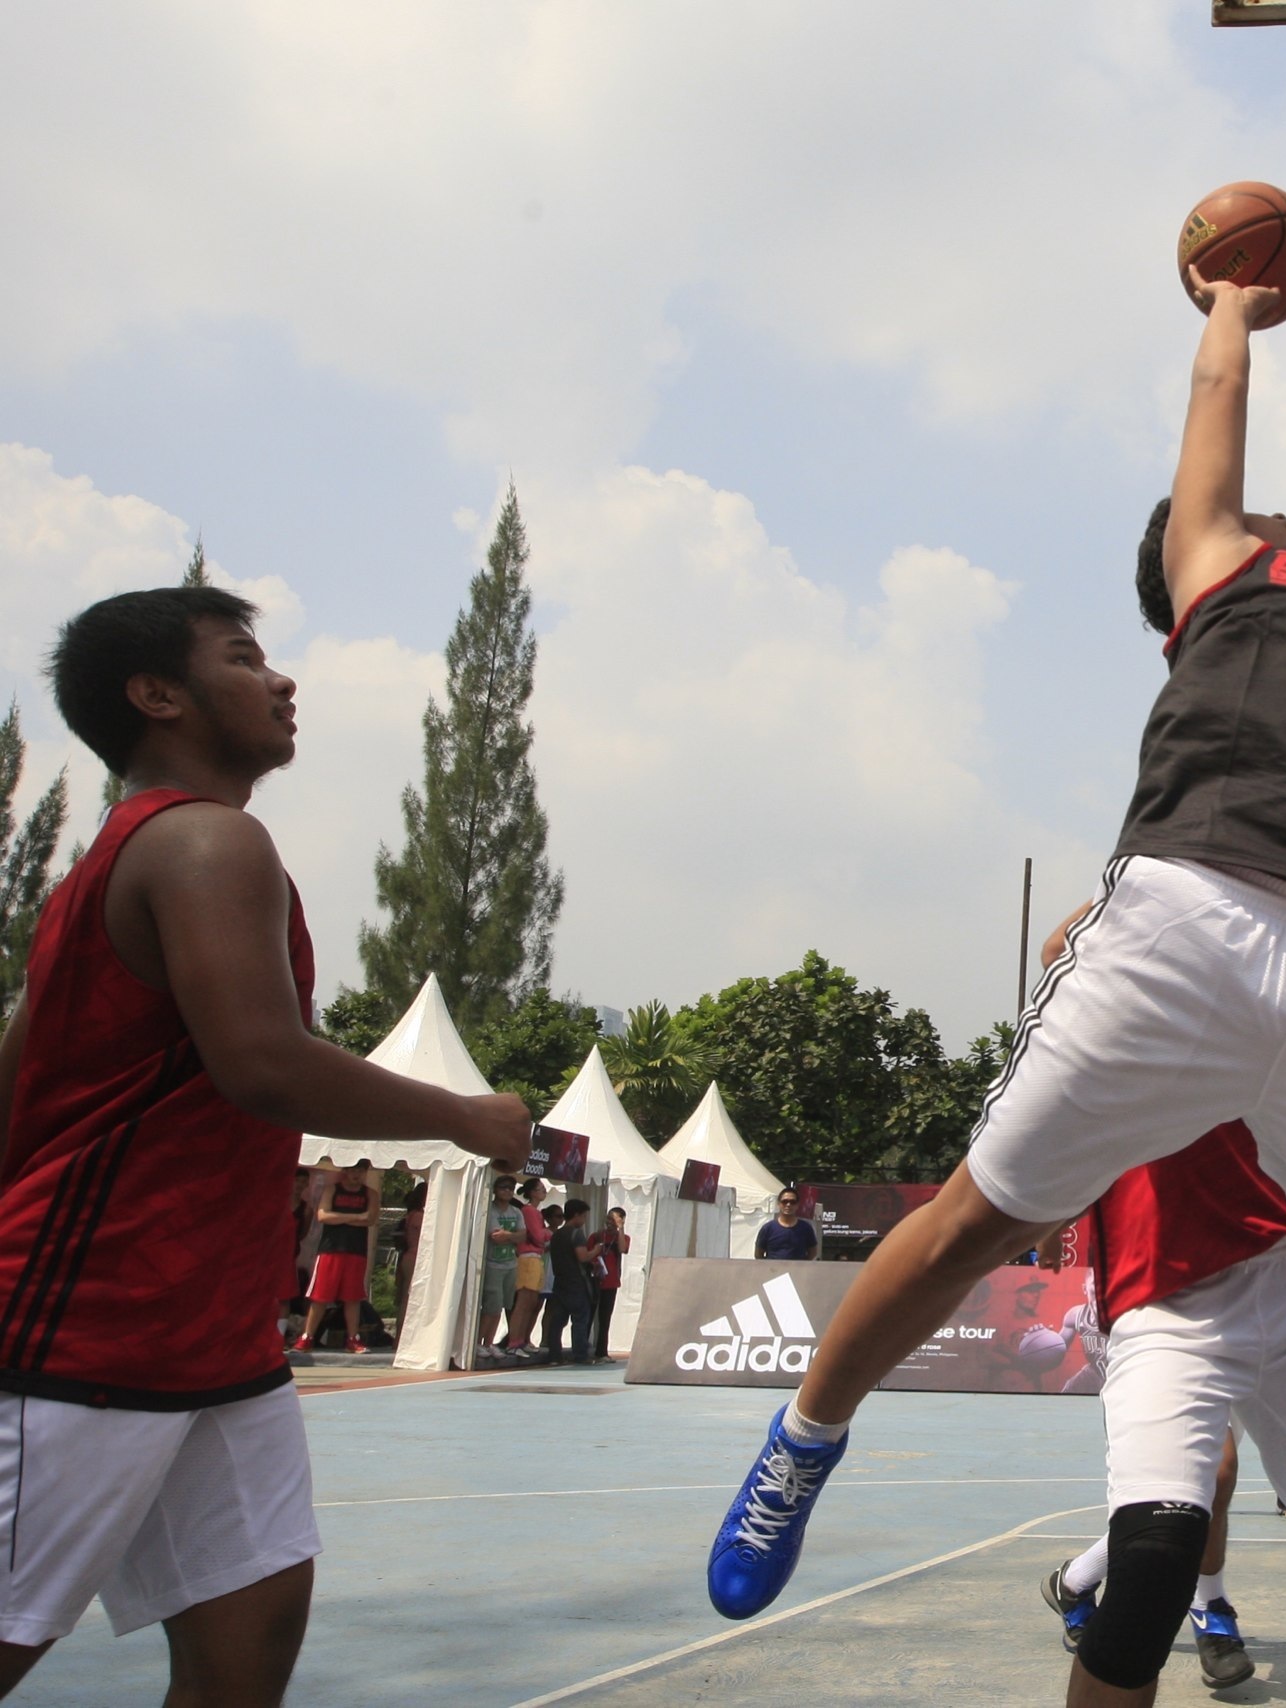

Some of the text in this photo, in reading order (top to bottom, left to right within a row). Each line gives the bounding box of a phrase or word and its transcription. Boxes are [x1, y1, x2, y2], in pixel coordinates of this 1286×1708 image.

[1213, 248, 1252, 281] ourt
[525, 1161, 545, 1175] booth
[959, 1325, 996, 1339] tour
